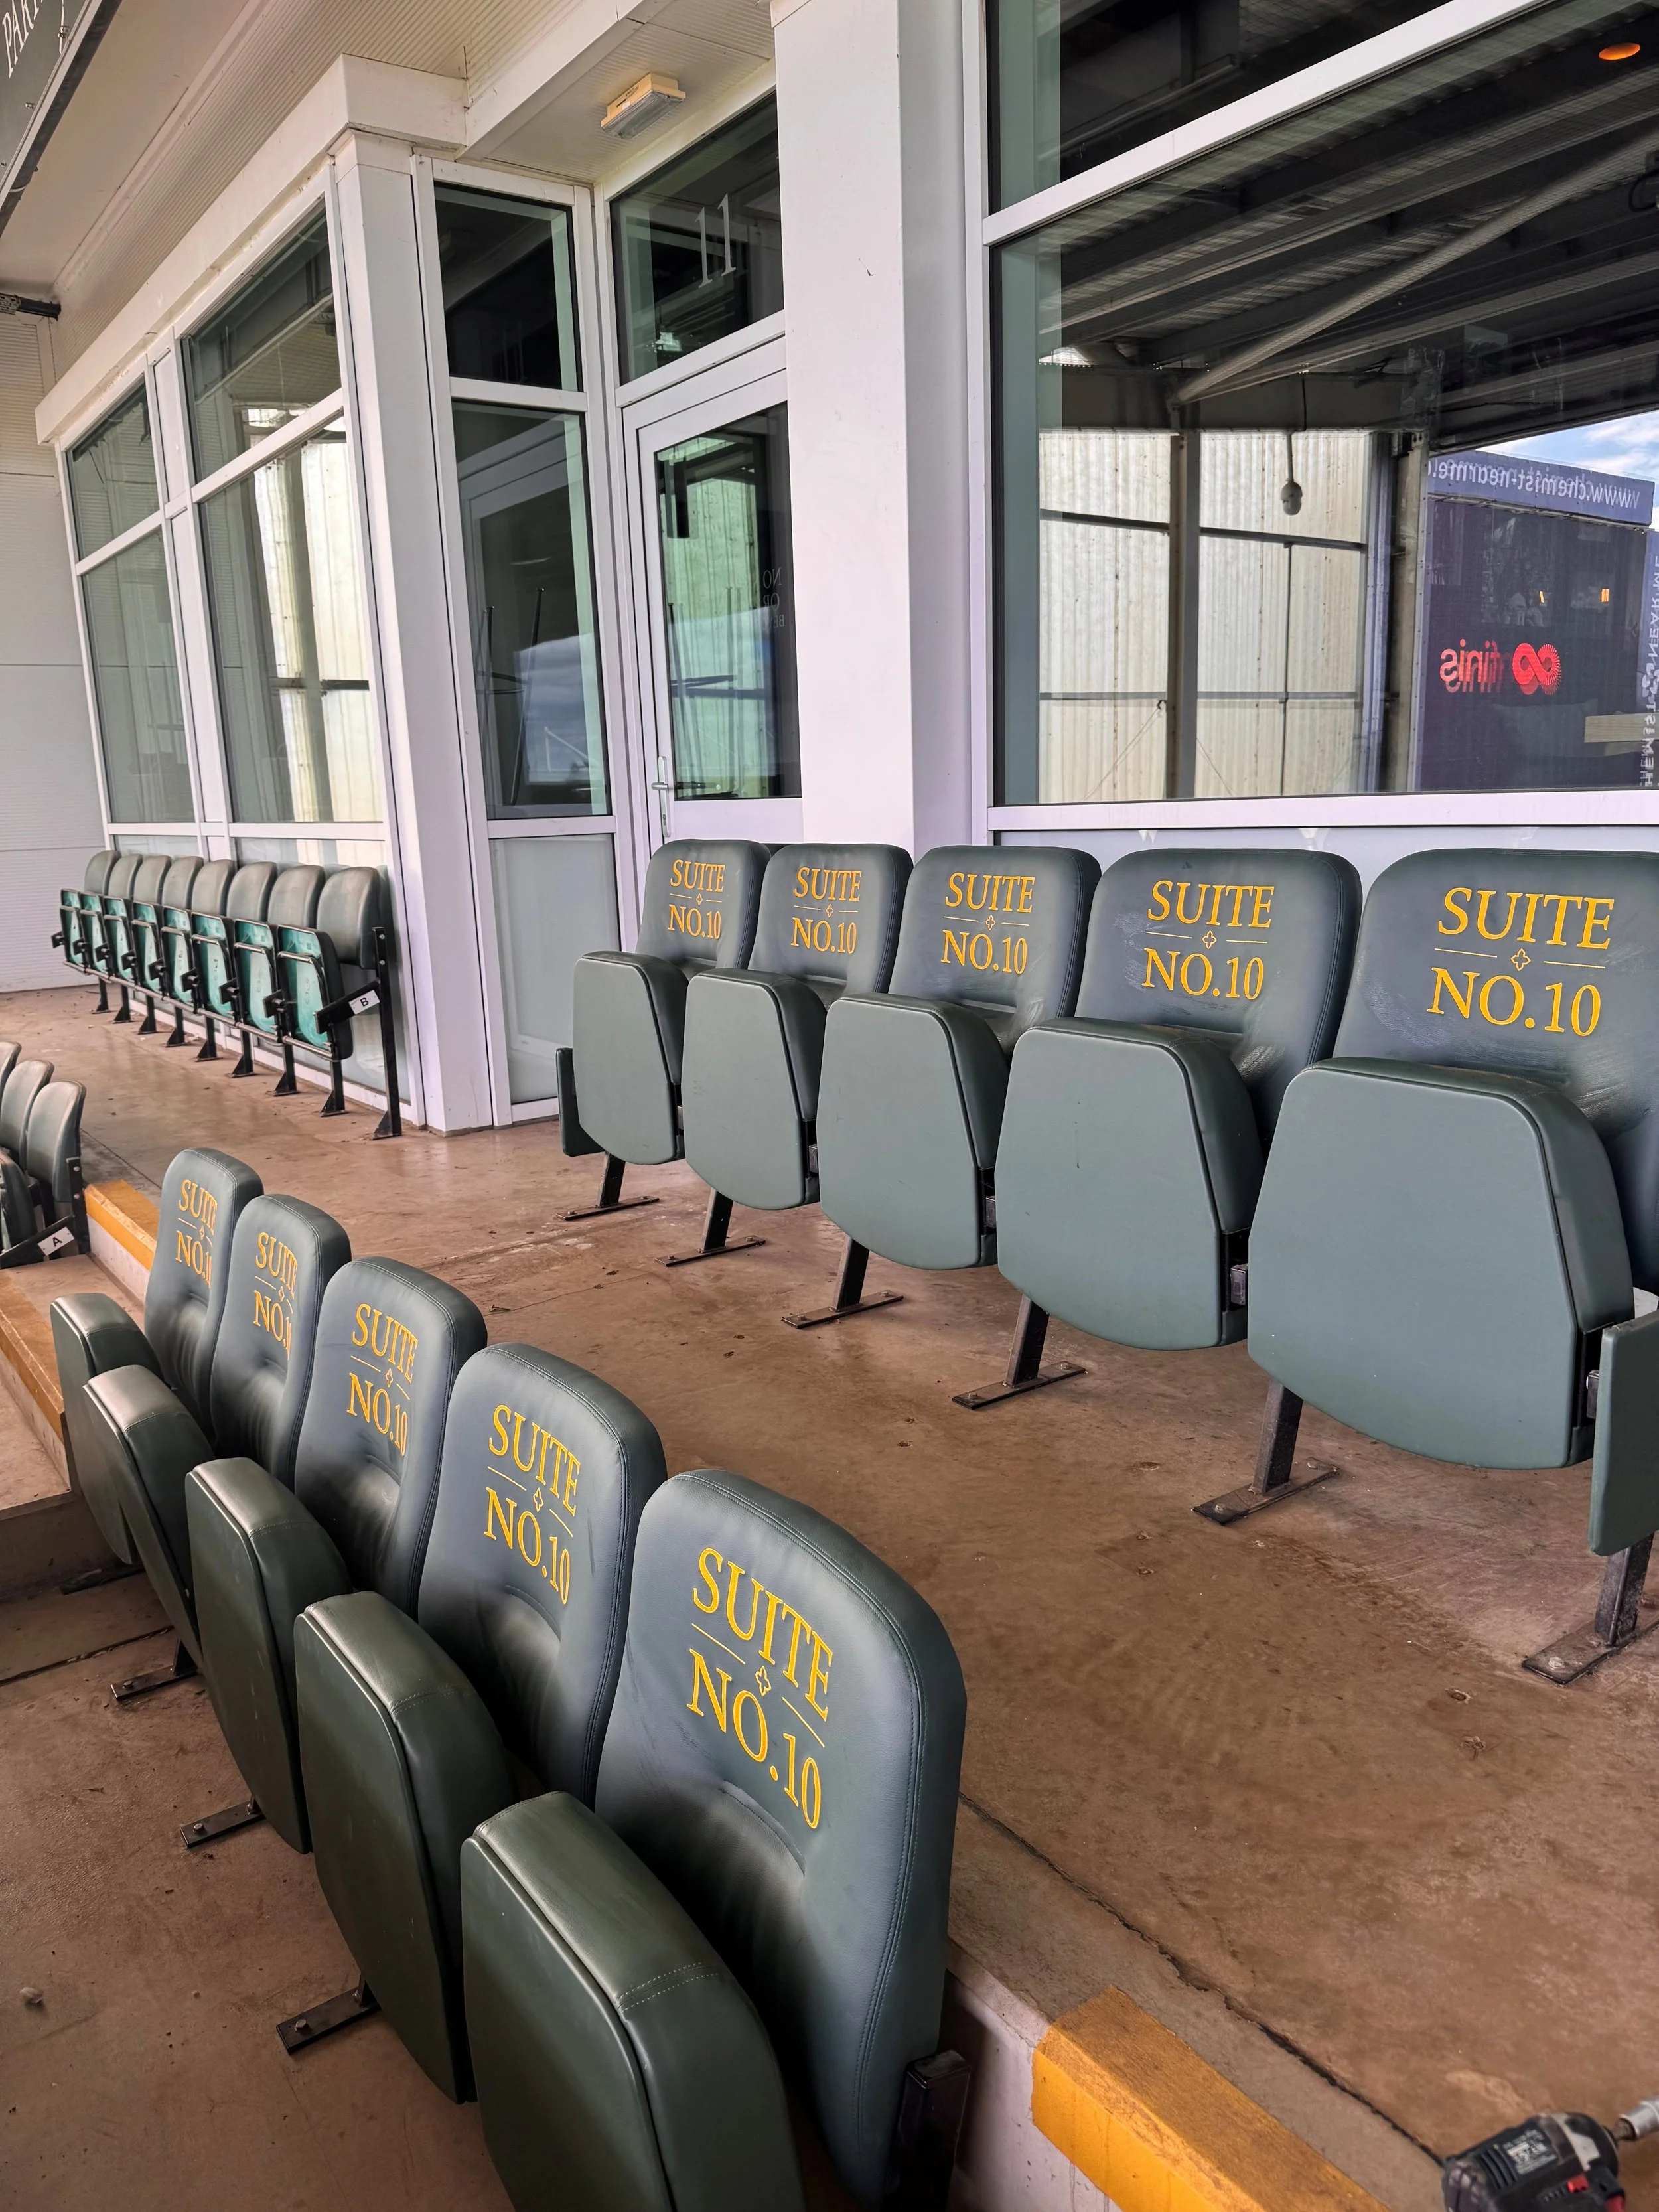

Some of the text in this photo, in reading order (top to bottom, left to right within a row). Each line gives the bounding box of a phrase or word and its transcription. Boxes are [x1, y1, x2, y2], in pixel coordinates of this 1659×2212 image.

[695, 192, 736, 288] 11
[670, 861, 725, 893] SUITE
[794, 867, 862, 902] SUITE
[945, 872, 1035, 913] SUITE
[668, 904, 721, 939] NO.10
[1147, 880, 1275, 929] SUITE
[1437, 887, 1615, 950] SUITE
[791, 917, 857, 954] NO.10
[941, 930, 1028, 974] NO.10
[1141, 948, 1264, 1000] NO.10
[360, 997, 369, 1007] B
[1427, 967, 1601, 1037] NO.10
[52, 1236, 63, 1247] A
[352, 1303, 419, 1384] SUITE
[346, 1372, 407, 1457] NO.10
[488, 1404, 581, 1517] SUITE
[484, 1487, 571, 1605] NO.10
[693, 1547, 833, 1722] SUITE
[686, 1647, 822, 1830] NO.10
